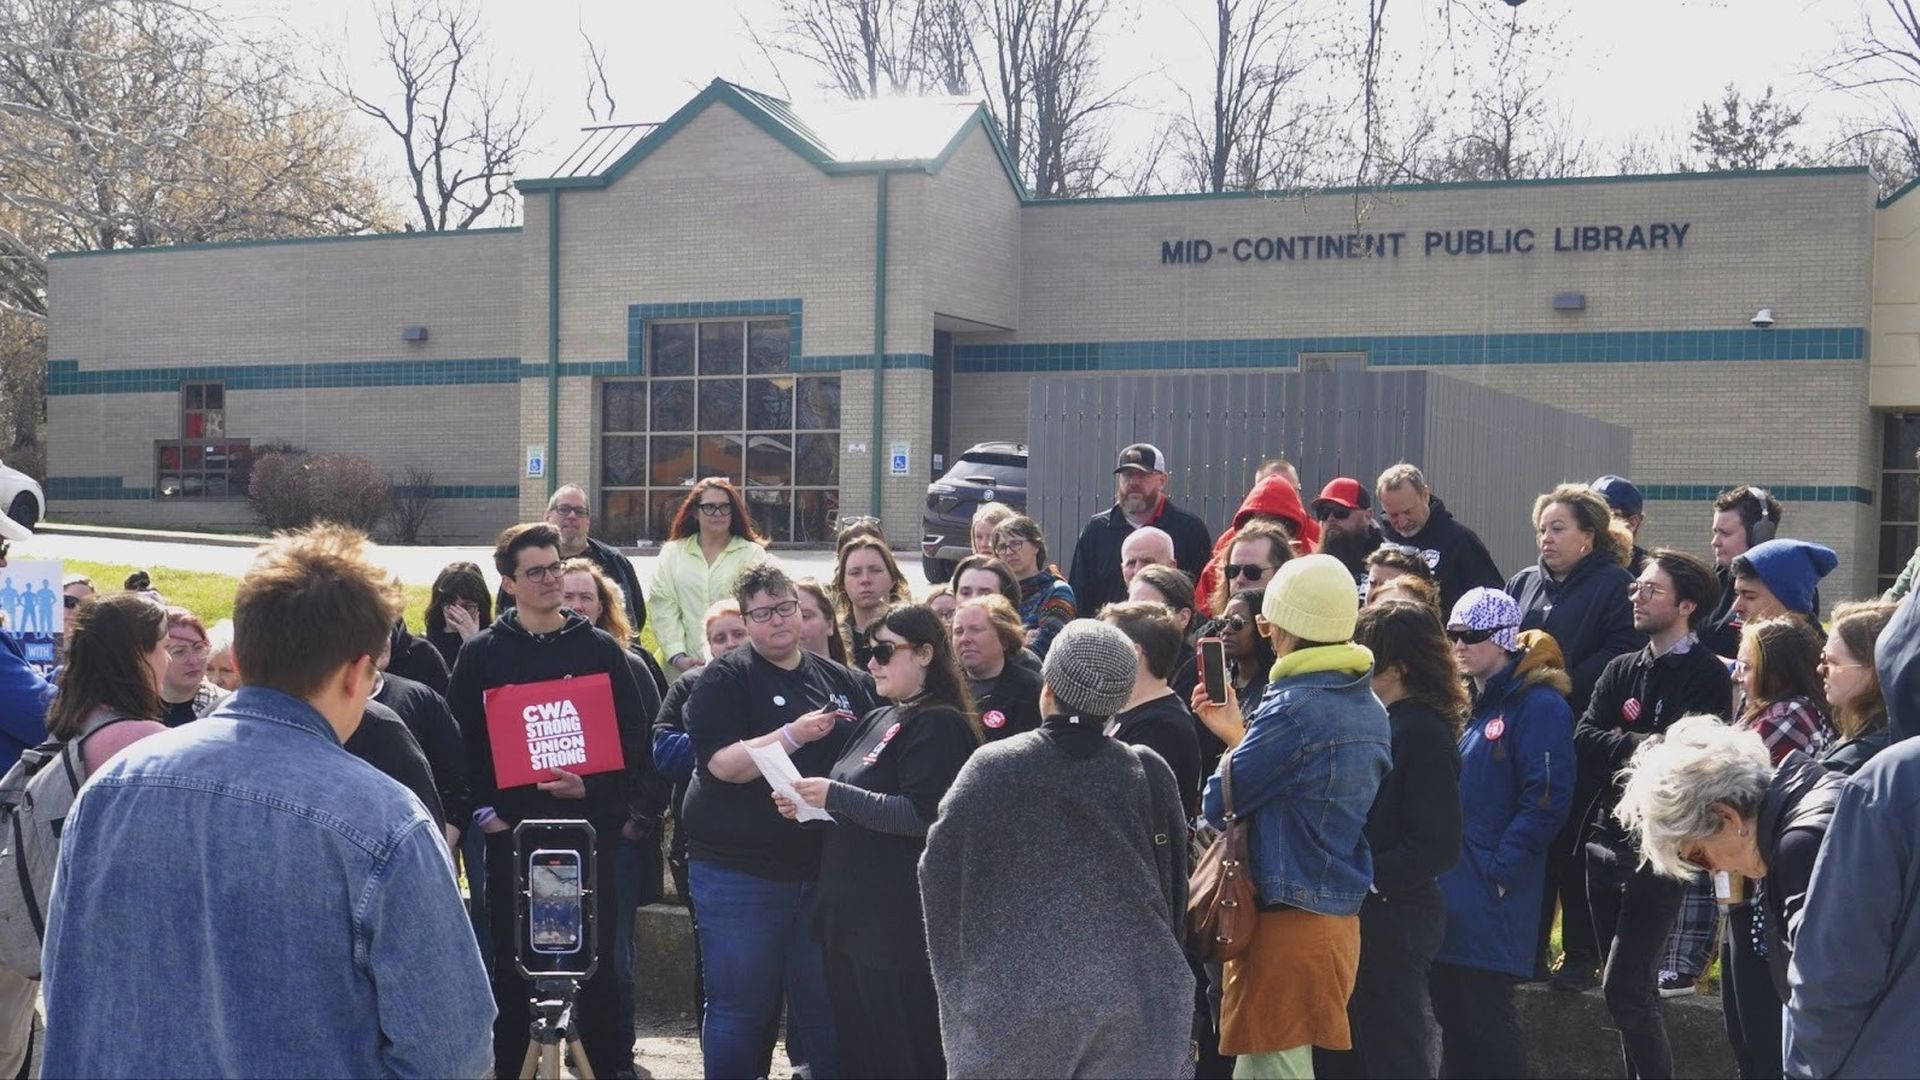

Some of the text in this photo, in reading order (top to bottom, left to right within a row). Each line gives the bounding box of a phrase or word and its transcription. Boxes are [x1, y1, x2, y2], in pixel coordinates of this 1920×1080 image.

[1161, 223, 1691, 264] MID-CONTINENT PUBLIC LIBRARY
[28, 646, 50, 658] WITH
[523, 700, 578, 722] CWA
[525, 716, 581, 739] STRONG
[528, 735, 585, 755] UNION
[531, 748, 587, 770] STRONG
